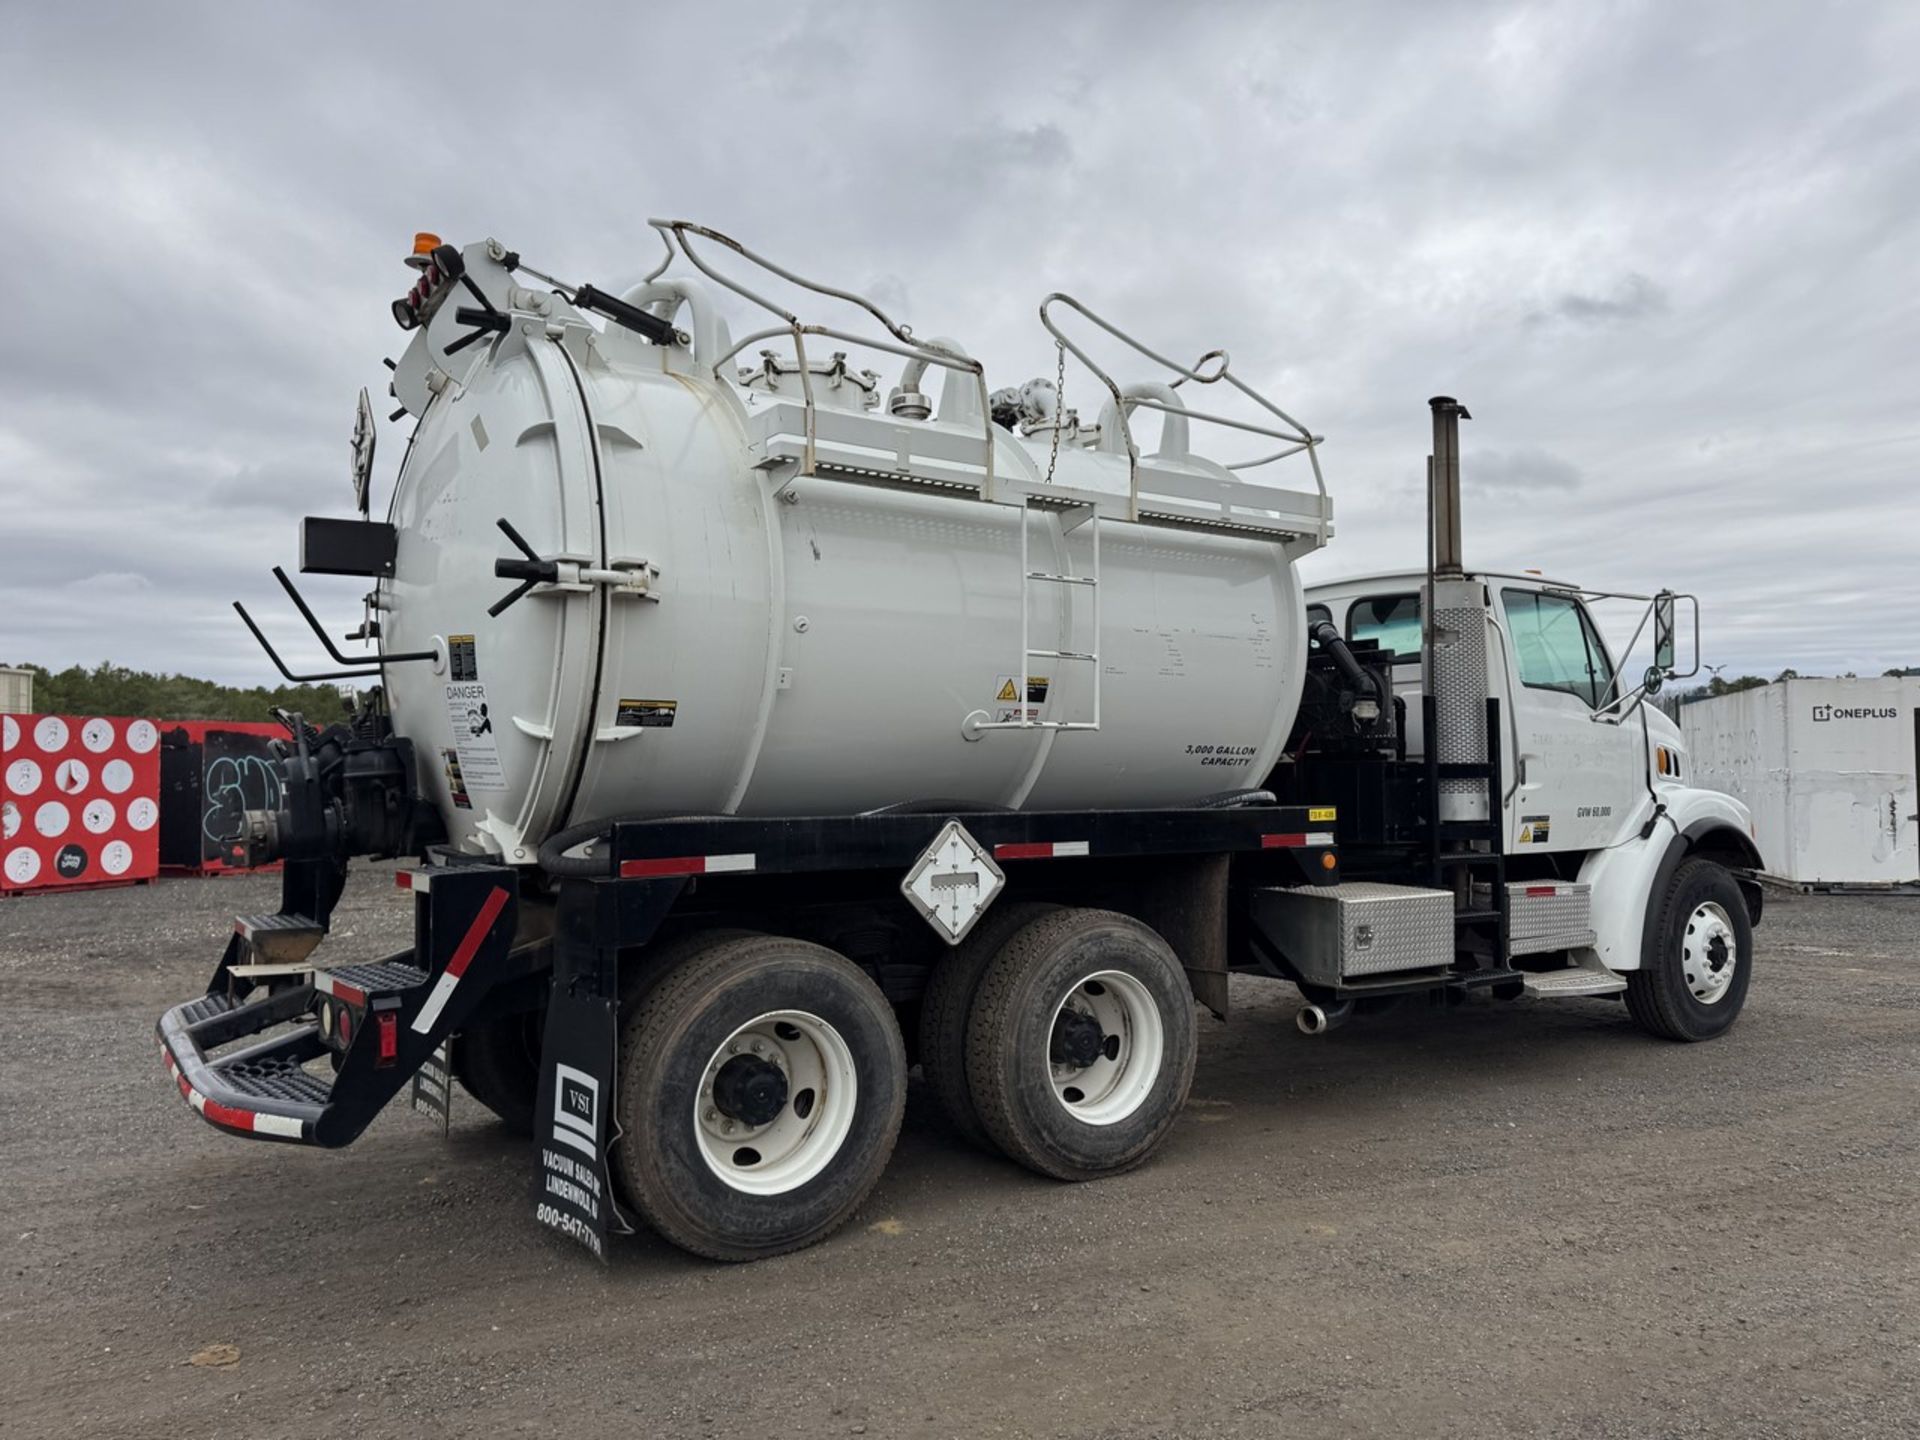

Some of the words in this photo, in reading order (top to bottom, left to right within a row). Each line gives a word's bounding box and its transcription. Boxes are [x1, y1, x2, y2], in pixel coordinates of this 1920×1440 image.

[447, 686, 485, 699] DANGER
[1833, 708, 1897, 718] ONEPLUS
[1185, 745, 1214, 755] 3,000
[1216, 746, 1256, 755] GALLON
[1201, 757, 1251, 766] CAPACITY
[569, 1089, 590, 1115] VSI
[543, 1149, 574, 1178] VACUUM
